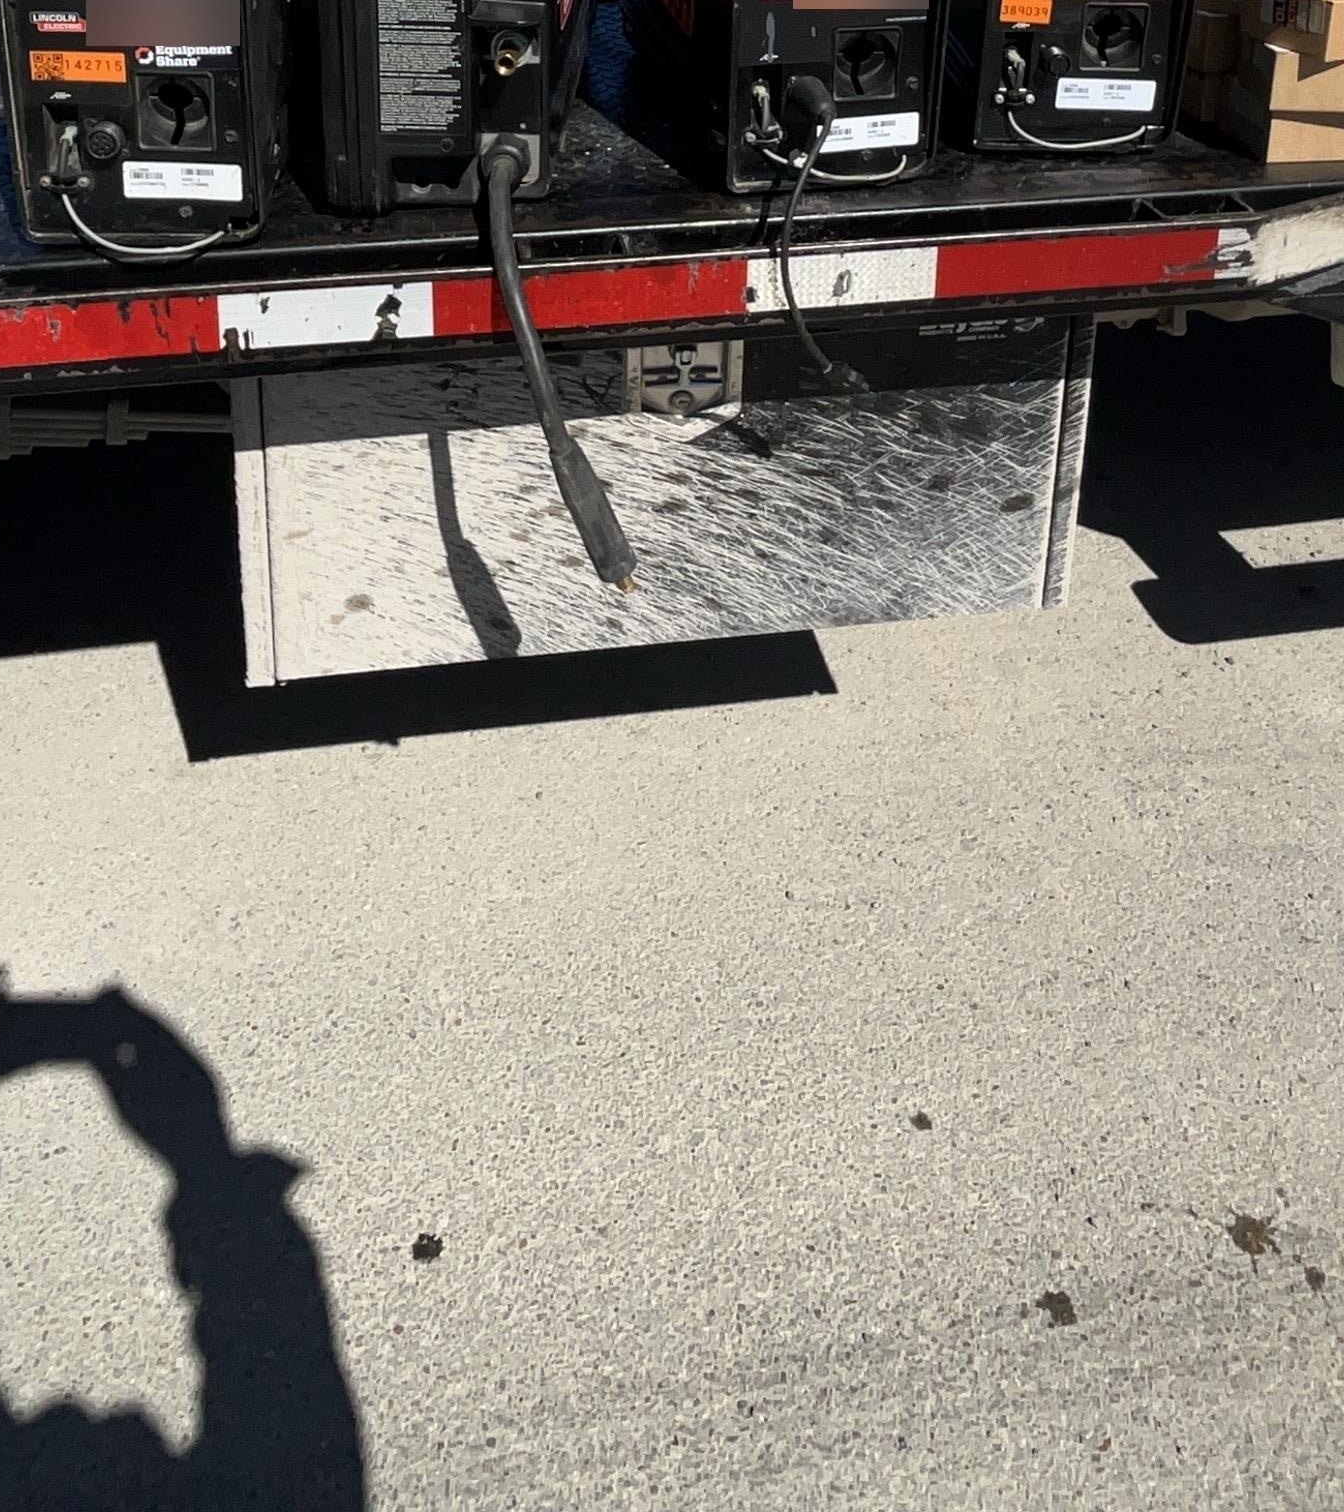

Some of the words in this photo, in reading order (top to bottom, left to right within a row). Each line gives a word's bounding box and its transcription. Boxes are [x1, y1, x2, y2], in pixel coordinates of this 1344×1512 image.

[1001, 4, 1049, 17] 389039
[32, 13, 77, 23] LINCOLN
[156, 45, 233, 57] Equipment
[63, 58, 124, 72] 142715
[156, 56, 199, 67] Share
